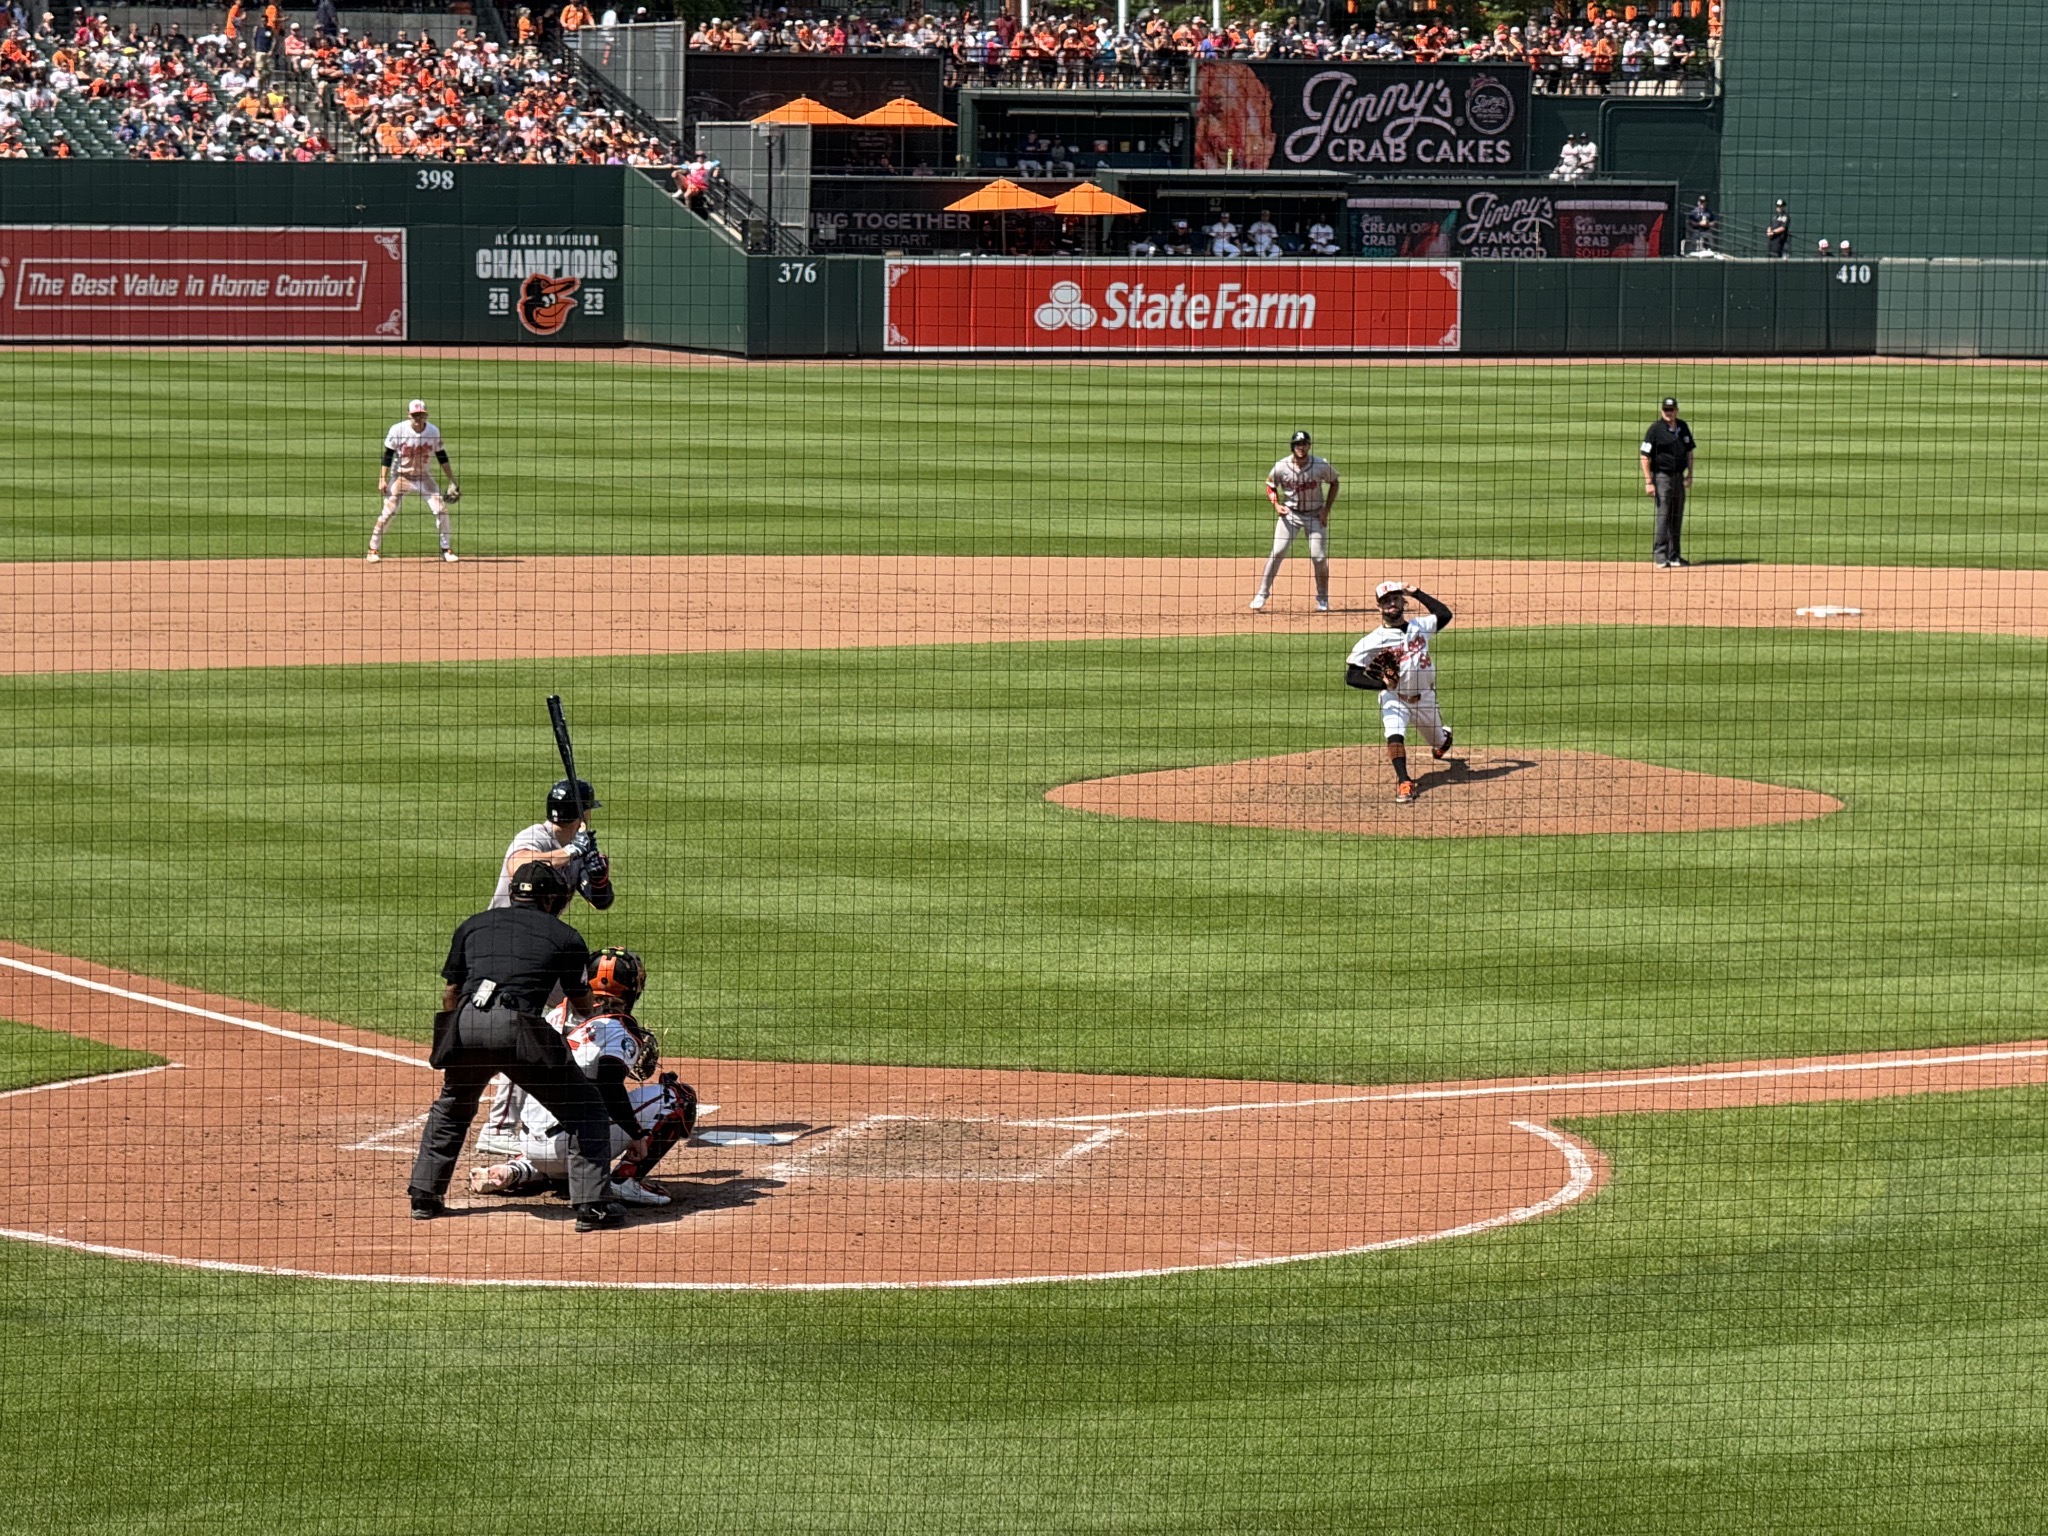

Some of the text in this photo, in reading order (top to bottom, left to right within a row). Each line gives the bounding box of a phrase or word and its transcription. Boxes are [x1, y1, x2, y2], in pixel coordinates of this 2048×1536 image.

[1284, 70, 1457, 163] Jimmy's
[1327, 138, 1512, 163] CRAB CAKES
[415, 169, 455, 190] 398
[852, 212, 971, 230] TOGETHER
[1457, 191, 1555, 245] Jimmy's
[1362, 222, 1407, 234] CREAM
[1478, 230, 1541, 244] FAMOUS
[1575, 223, 1647, 235] MARYLAND
[512, 233, 542, 246] EAST
[848, 233, 879, 246] THE
[1362, 234, 1397, 246] CRAB
[1575, 235, 1609, 247] CRAB
[1470, 246, 1547, 258] SEAFOOD
[475, 248, 618, 279] CHAMPIONS
[777, 262, 817, 283] 376
[1835, 264, 1871, 284] 410
[28, 272, 357, 297] The Best Value in Home Comfort
[488, 292, 509, 310] 20
[583, 292, 604, 310] 23
